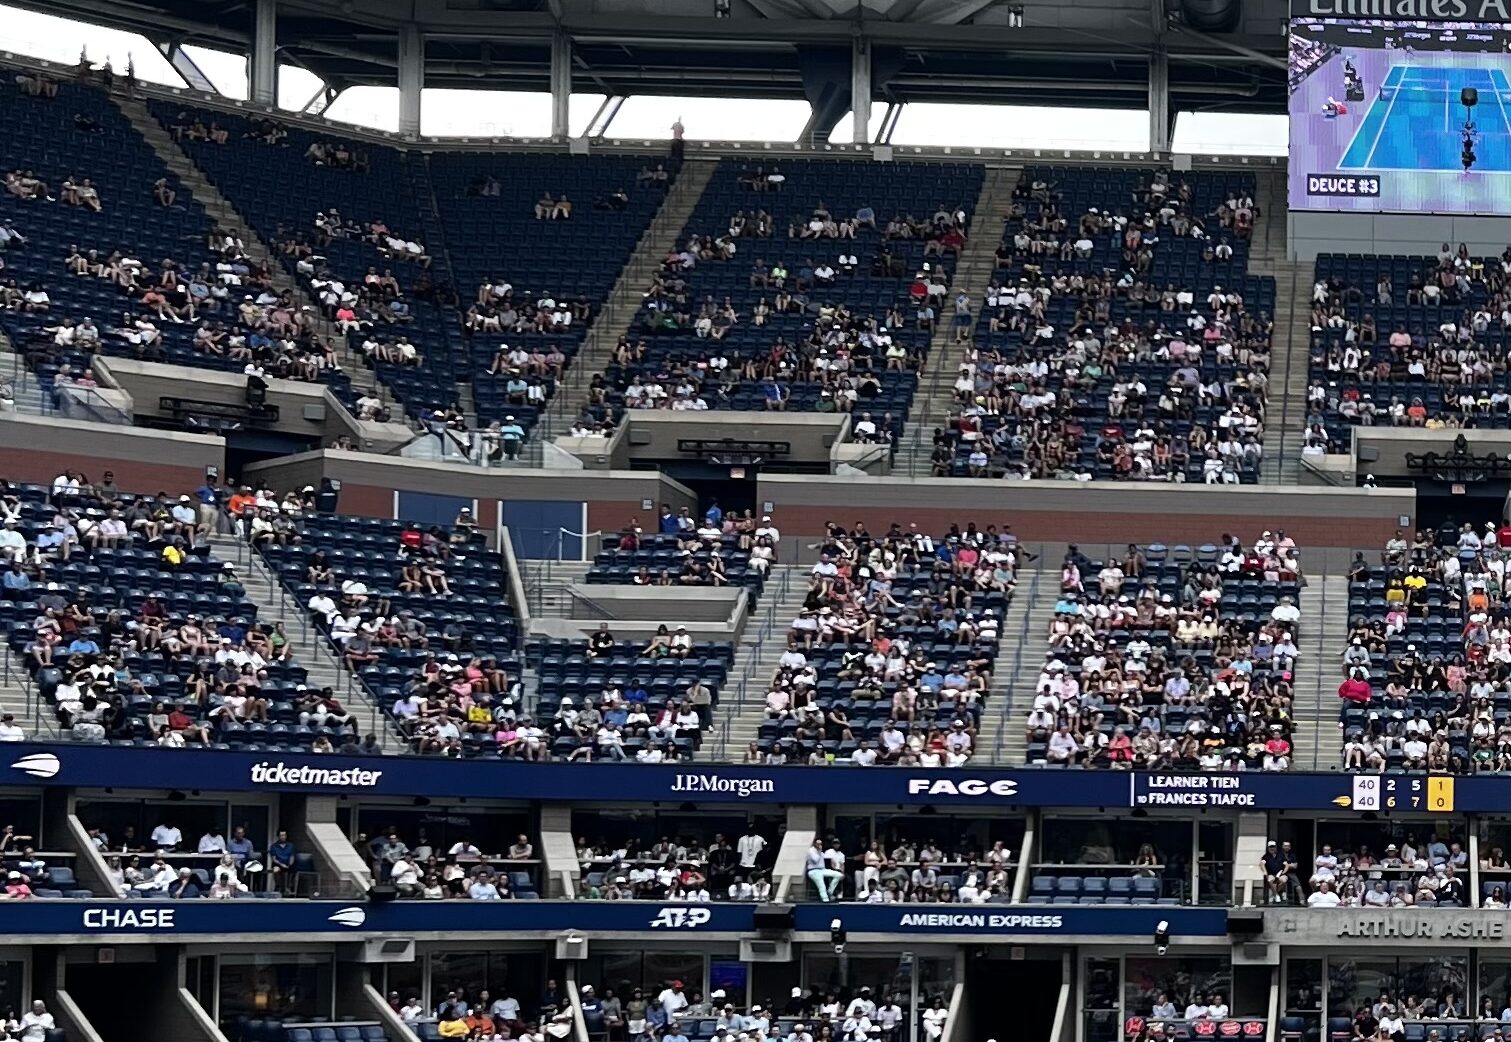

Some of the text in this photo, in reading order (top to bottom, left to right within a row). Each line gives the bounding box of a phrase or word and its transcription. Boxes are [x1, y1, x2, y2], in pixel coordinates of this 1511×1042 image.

[1310, 179, 1378, 194] DEUCE #3
[251, 762, 381, 786] ticketmaster
[1149, 776, 1443, 791] LEARNER TIEN 40 2 5 1
[671, 774, 774, 796] J.P.Morgan
[1149, 793, 1207, 805] FRANCES
[1210, 794, 1255, 805] TIAFOE
[1359, 797, 1375, 807] 40
[1387, 797, 1396, 807] 6
[1412, 797, 1420, 807] 7
[1437, 798, 1445, 807] 0
[83, 909, 175, 928] CHASE
[648, 907, 711, 928] ATP
[900, 913, 1062, 928] AMERICAN EXPRESS
[1338, 919, 1432, 938] ARTHUR
[1440, 919, 1502, 939] ASHE
